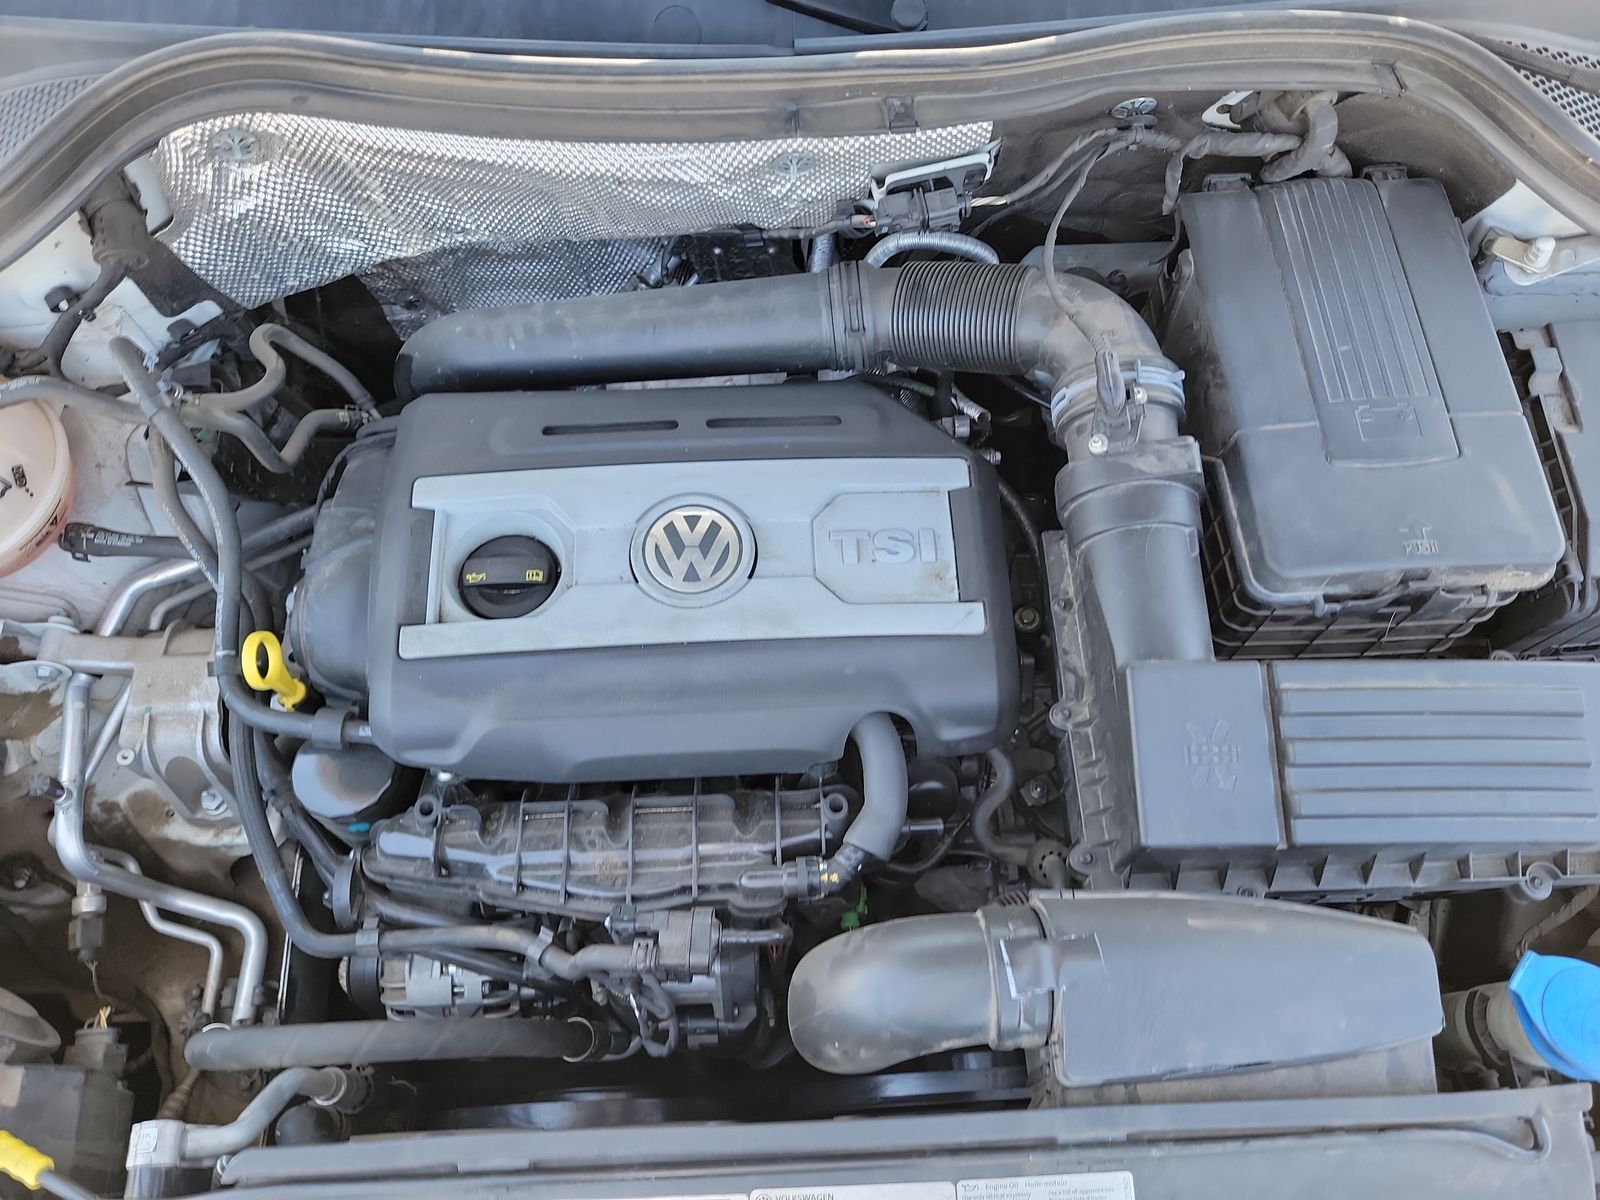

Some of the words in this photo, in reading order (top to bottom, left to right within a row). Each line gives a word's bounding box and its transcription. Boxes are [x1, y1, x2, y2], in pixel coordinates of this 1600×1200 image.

[829, 528, 938, 566] TSI
[1404, 540, 1439, 555] PUSH
[985, 1183, 1007, 1192] Engine
[1009, 1181, 1019, 1190] Oil
[1025, 1180, 1042, 1188] Huile
